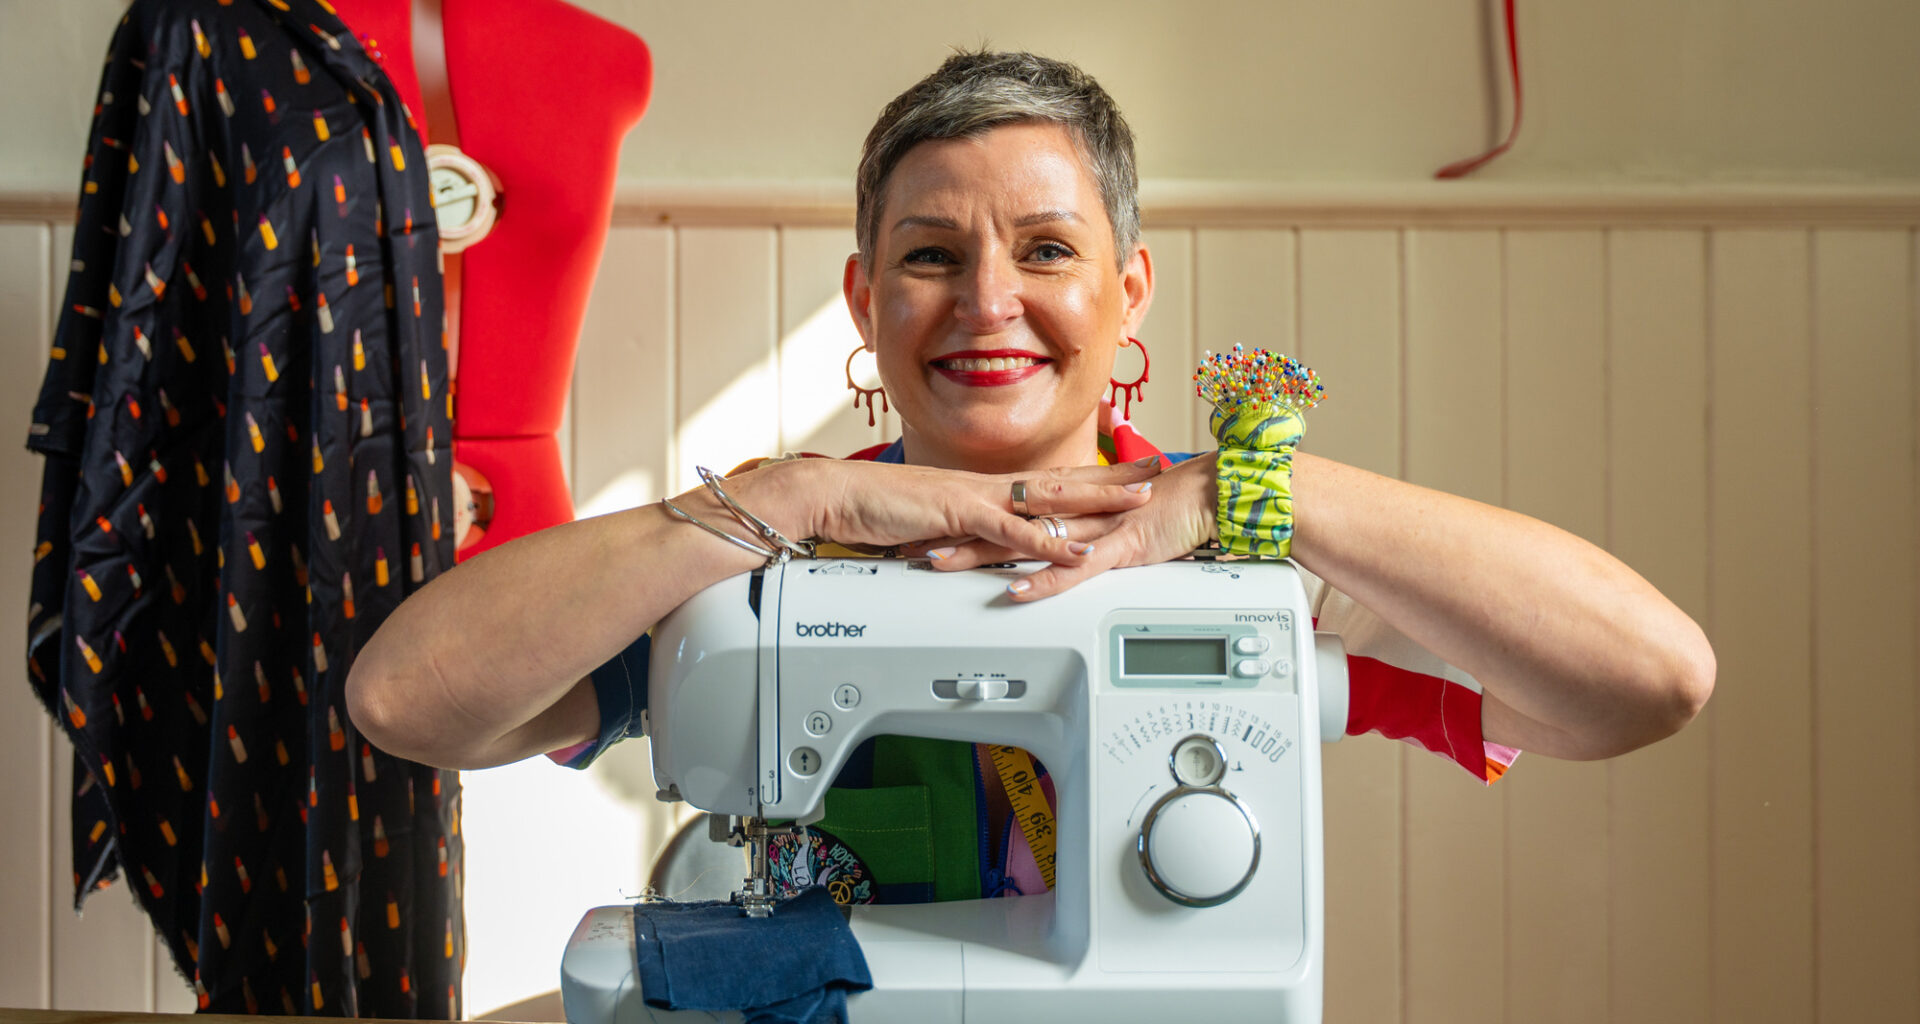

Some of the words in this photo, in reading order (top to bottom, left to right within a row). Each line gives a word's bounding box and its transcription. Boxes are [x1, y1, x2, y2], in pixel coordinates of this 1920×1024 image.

[796, 622, 867, 638] brother
[1279, 623, 1290, 631] 15
[1212, 702, 1220, 711] 10
[1225, 705, 1232, 713] 11
[1239, 709, 1247, 718] 12
[1262, 721, 1271, 730] 14
[768, 769, 775, 779] 3
[1013, 770, 1034, 796] 40
[1030, 811, 1052, 839] 39
[828, 842, 859, 871] HOPE
[793, 866, 812, 891] LO
